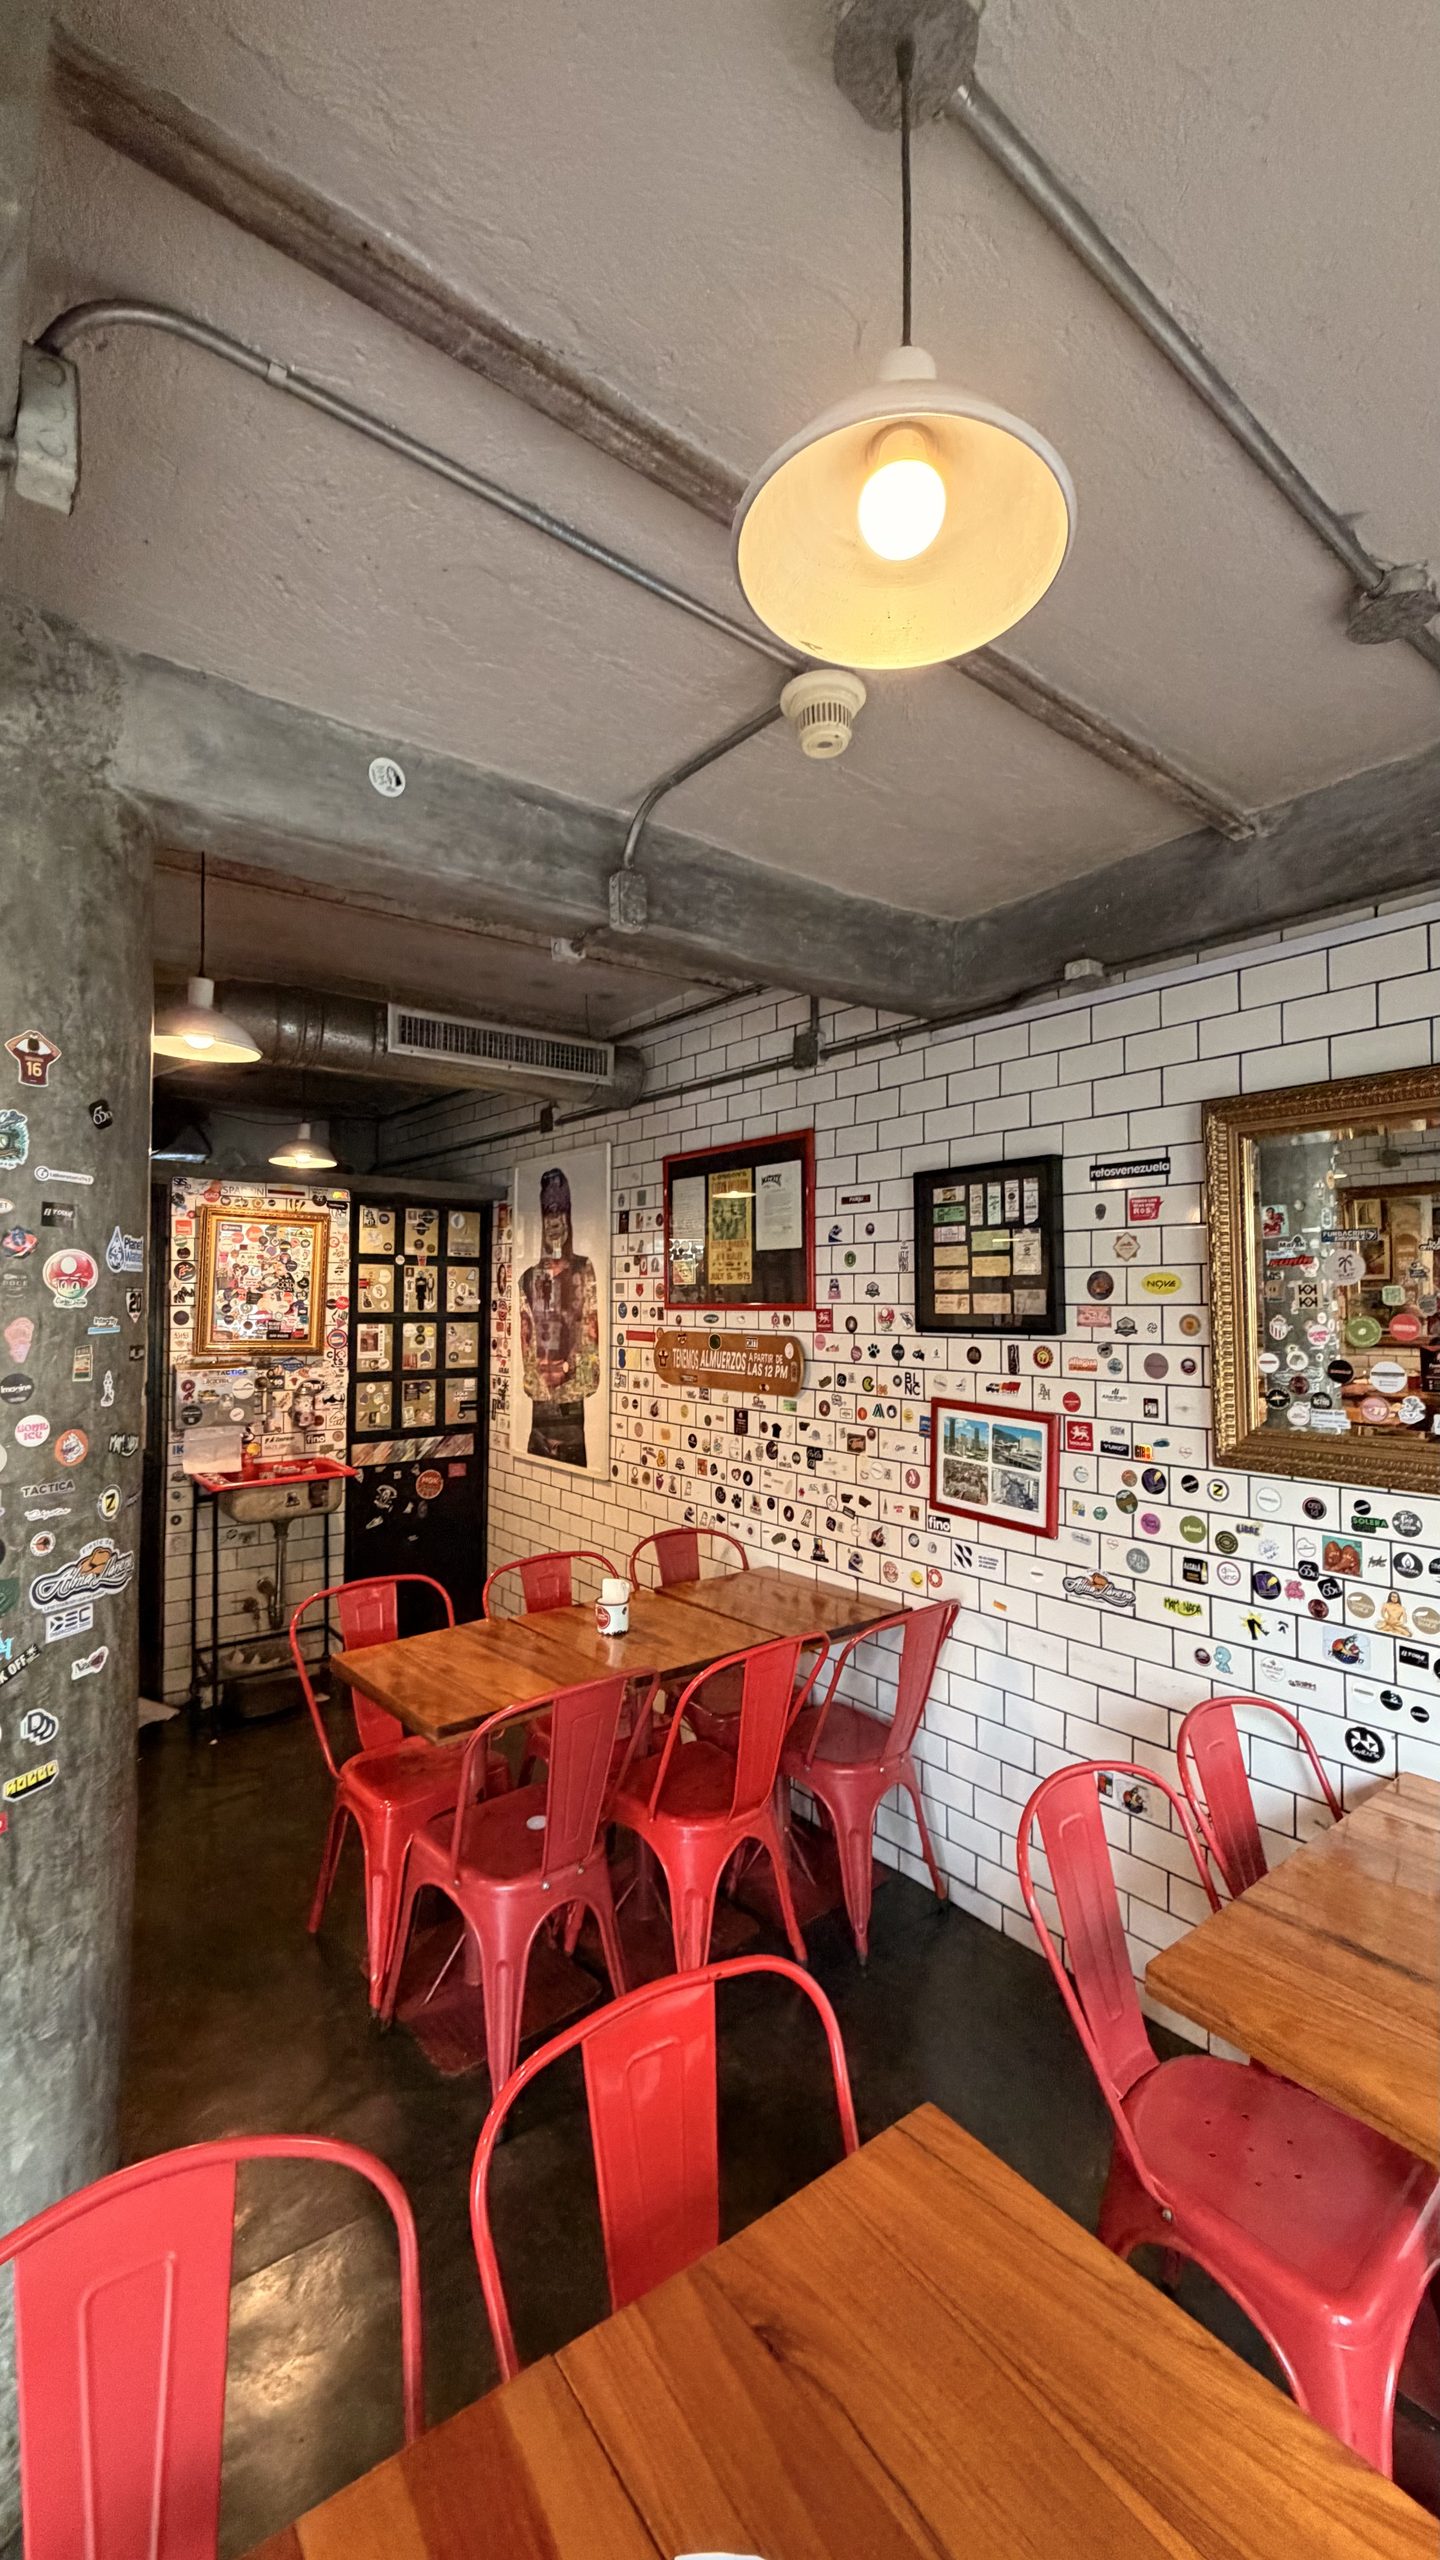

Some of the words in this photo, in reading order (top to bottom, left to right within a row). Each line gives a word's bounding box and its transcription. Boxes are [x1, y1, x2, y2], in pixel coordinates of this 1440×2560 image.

[26, 1061, 42, 1077] 16
[1090, 1161, 1170, 1179] retosvenezuela
[673, 1348, 699, 1370] TENEMOS
[700, 1349, 746, 1371] ALMUERZOS
[754, 1352, 773, 1364] PARTIR
[775, 1354, 783, 1364] DE
[747, 1362, 763, 1376] LAS
[764, 1364, 773, 1378] 12
[774, 1364, 789, 1380] PM
[306, 1434, 325, 1443] fino
[22, 1480, 75, 1497] TACTICA
[928, 1516, 951, 1532] fino
[1352, 1517, 1388, 1527] SOLERA
[7, 1653, 28, 1676] OFF
